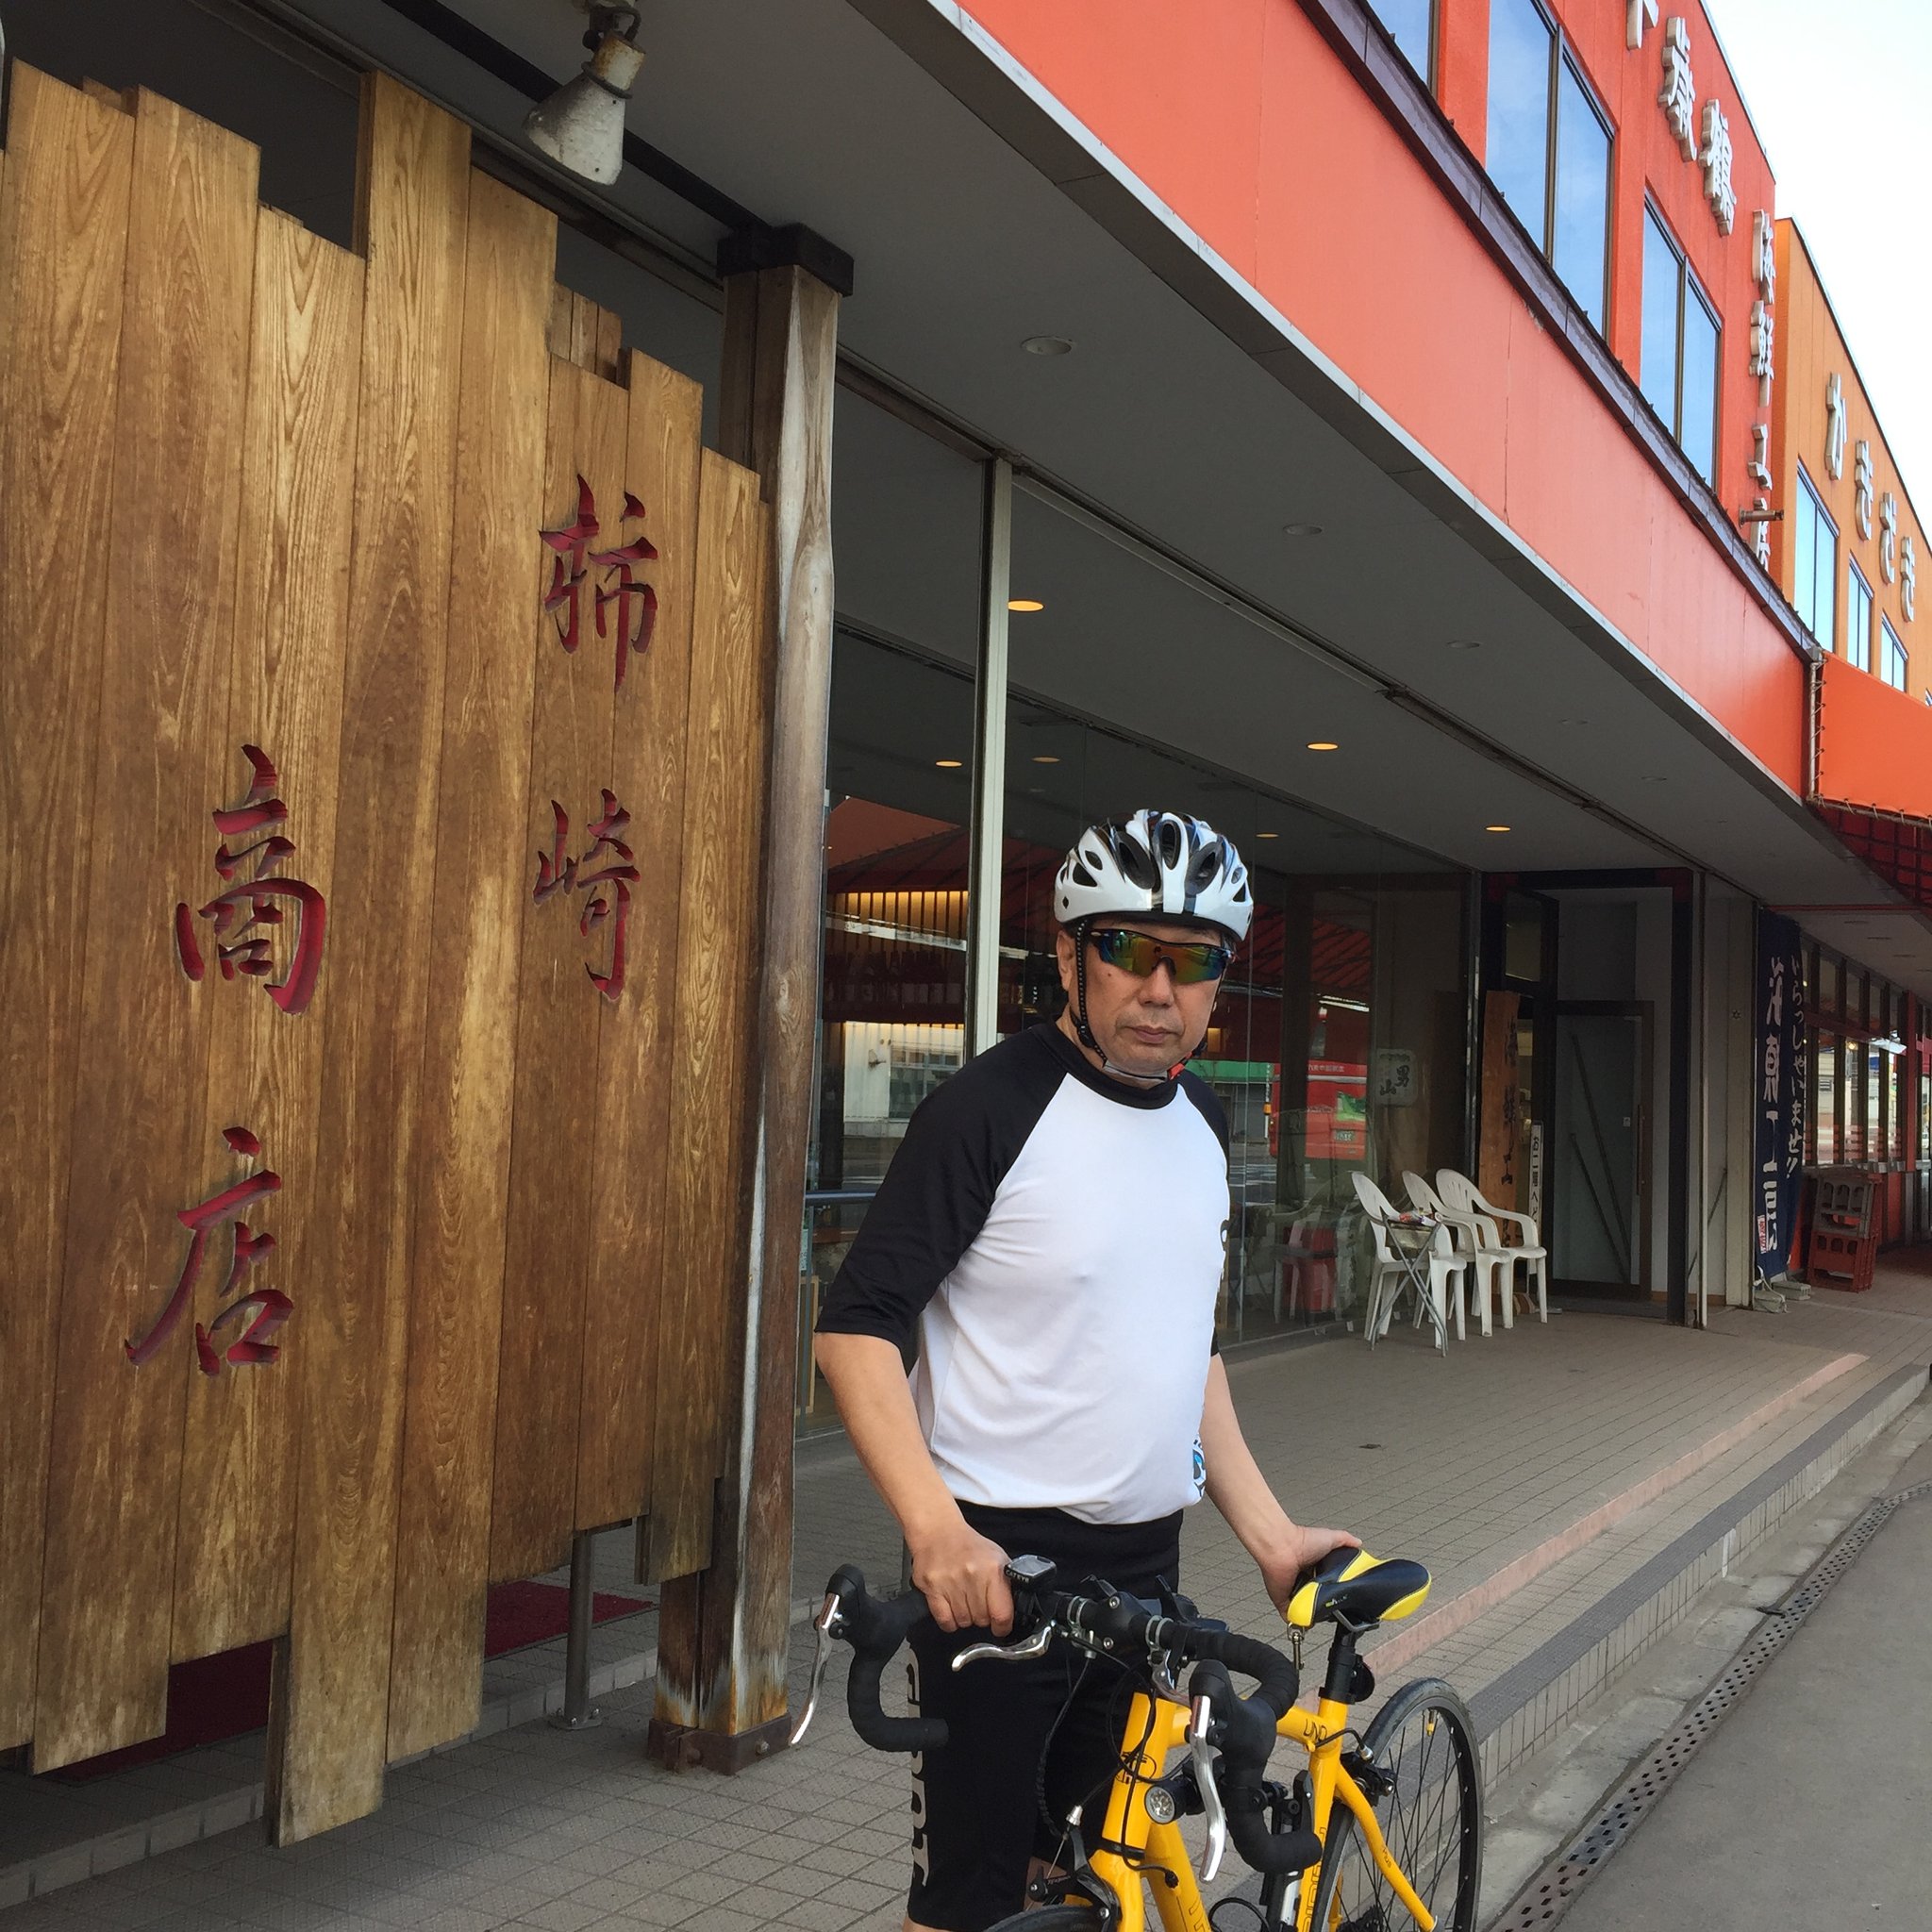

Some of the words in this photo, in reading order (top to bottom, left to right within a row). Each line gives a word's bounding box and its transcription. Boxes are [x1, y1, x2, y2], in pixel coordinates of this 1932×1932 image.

[534, 474, 658, 1001] 柿崎
[124, 743, 326, 1376] 商店
[1005, 1569, 1030, 1584] CATEYE
